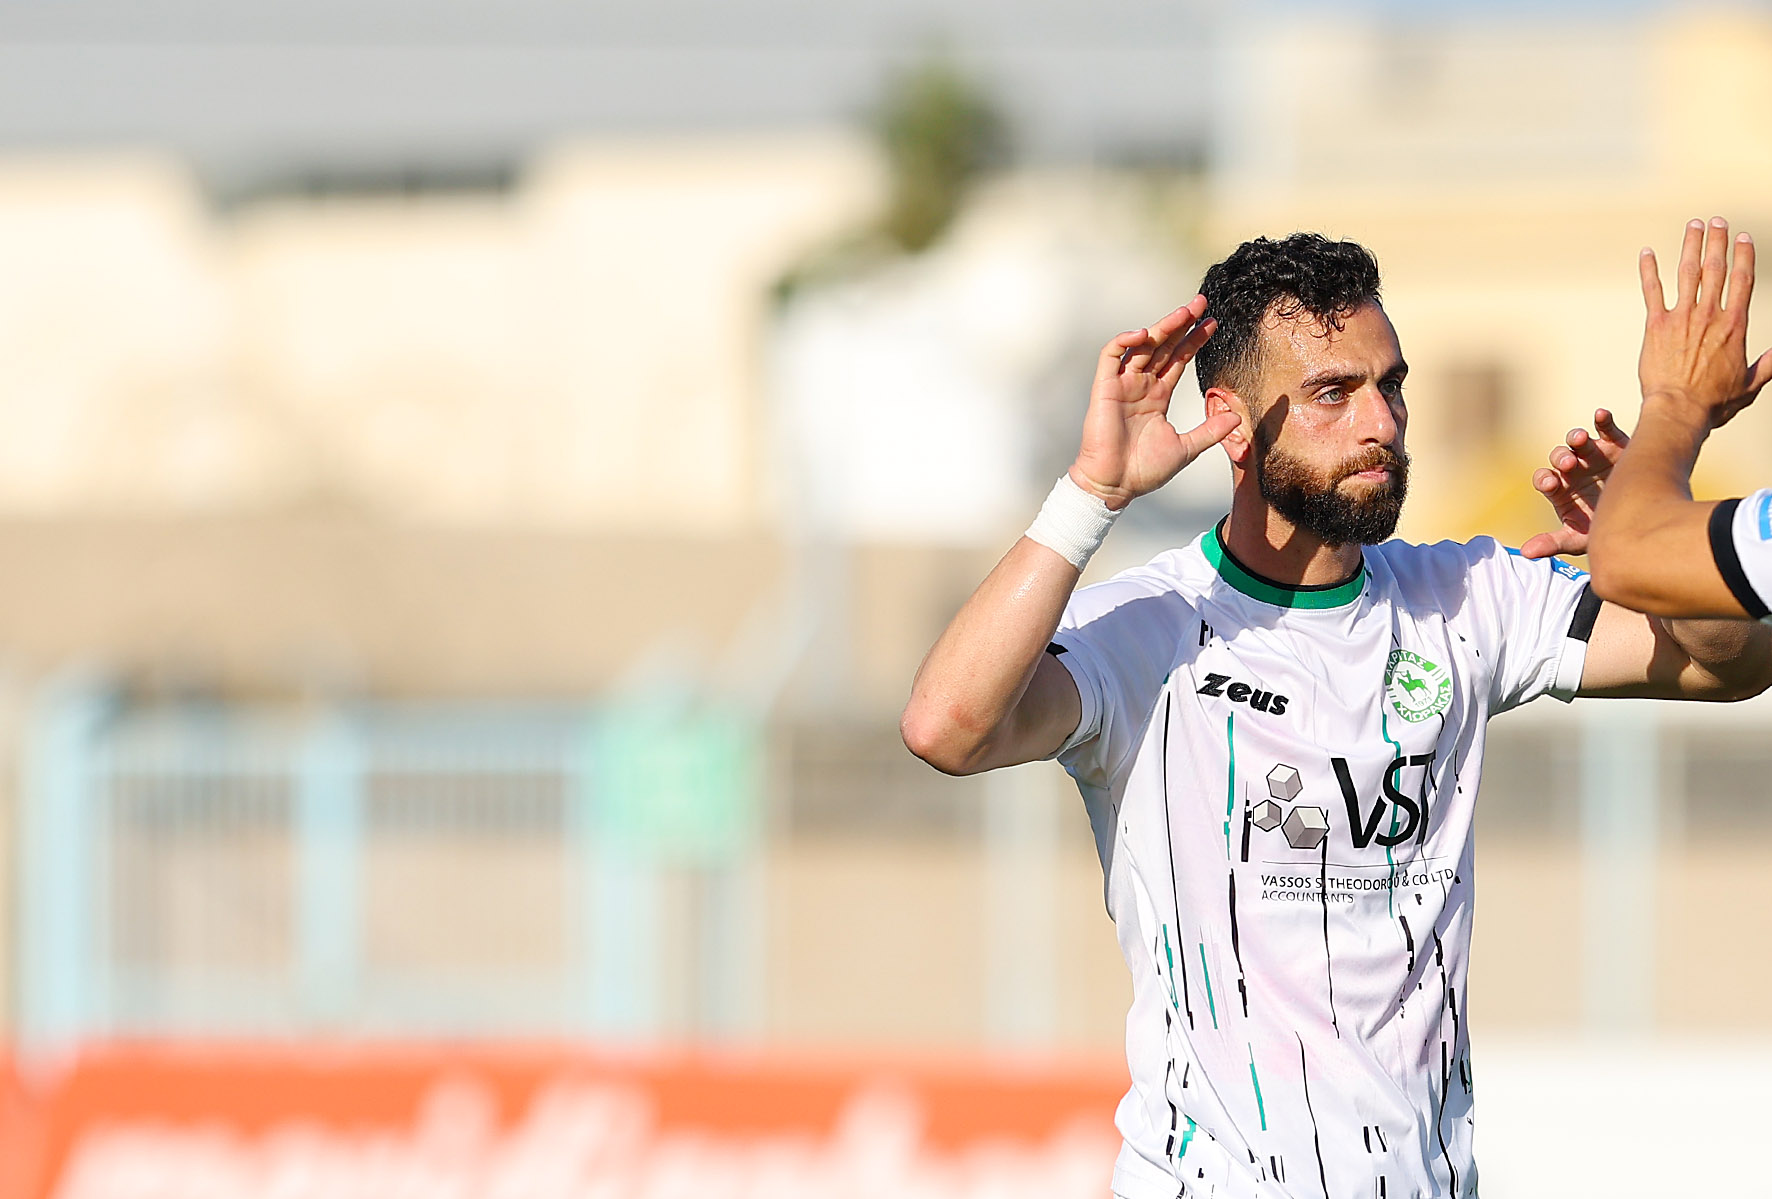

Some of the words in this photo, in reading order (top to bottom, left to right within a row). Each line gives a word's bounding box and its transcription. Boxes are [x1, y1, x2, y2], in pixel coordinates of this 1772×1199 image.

[1330, 749, 1436, 849] VST
[1261, 874, 1312, 889] VASSOS
[1432, 868, 1455, 883] LTD
[1261, 889, 1354, 904] ACCOUNTANTS
